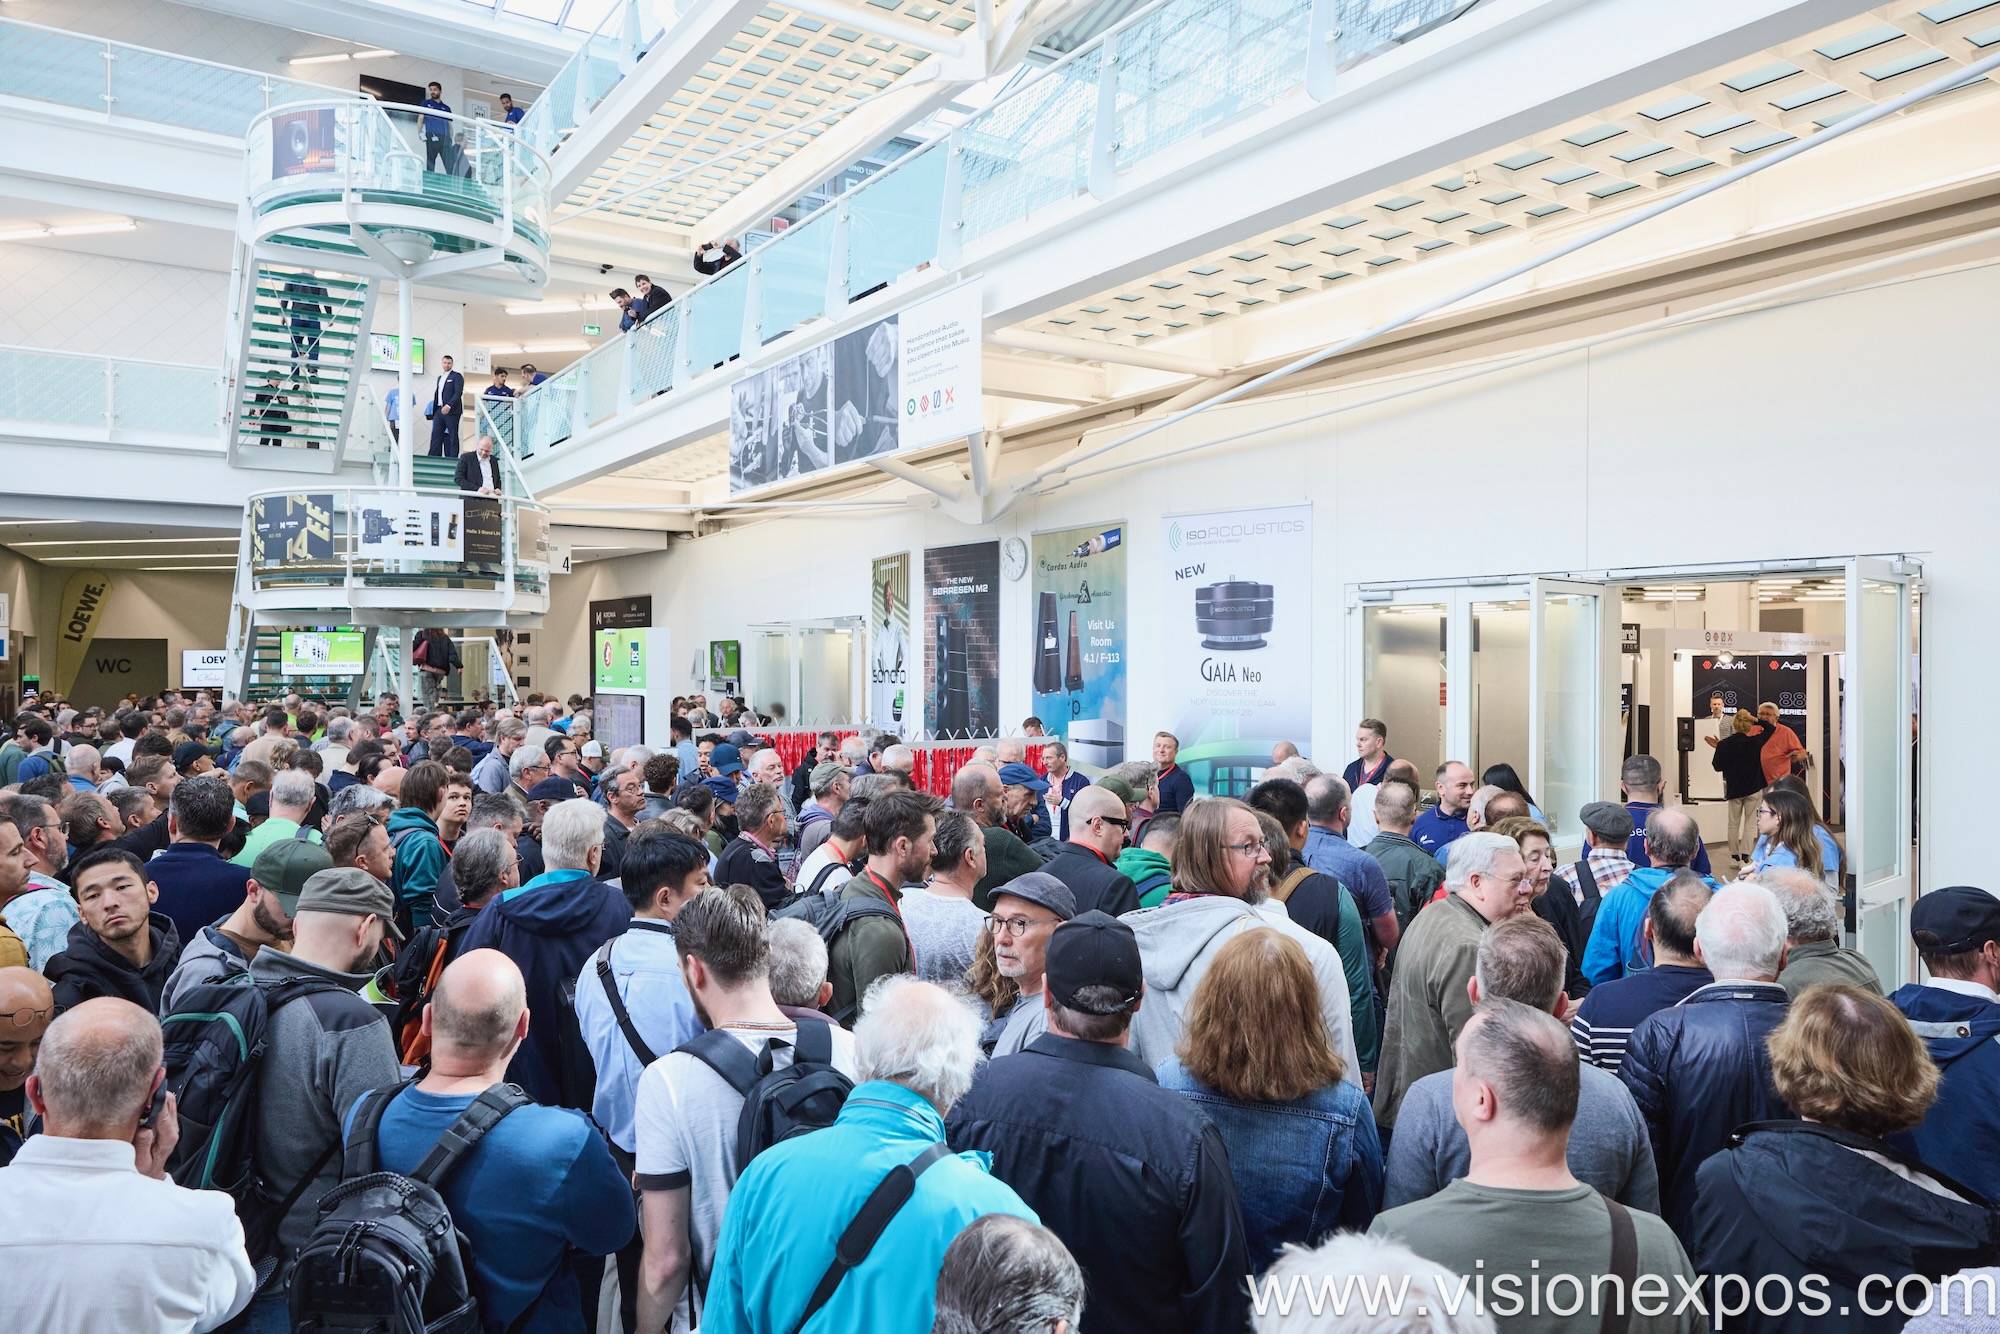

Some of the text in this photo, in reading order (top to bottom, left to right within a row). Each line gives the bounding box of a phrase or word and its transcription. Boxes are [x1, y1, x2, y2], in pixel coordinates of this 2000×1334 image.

[562, 556, 570, 572] 4
[1046, 560, 1088, 572] Cardas Audio
[1175, 563, 1206, 581] NEW
[946, 576, 974, 585] THE NEW
[976, 584, 988, 593] M2
[64, 583, 106, 643] LOEWE.
[1088, 620, 1115, 630] Visit Us
[1090, 636, 1112, 647] Room
[1084, 653, 1094, 663] 4.1
[1100, 653, 1120, 663] F-113
[96, 658, 132, 674] WC
[1200, 658, 1262, 682] GAIA Neo
[1713, 661, 1747, 670] Aavik
[1778, 692, 1806, 708] 88
